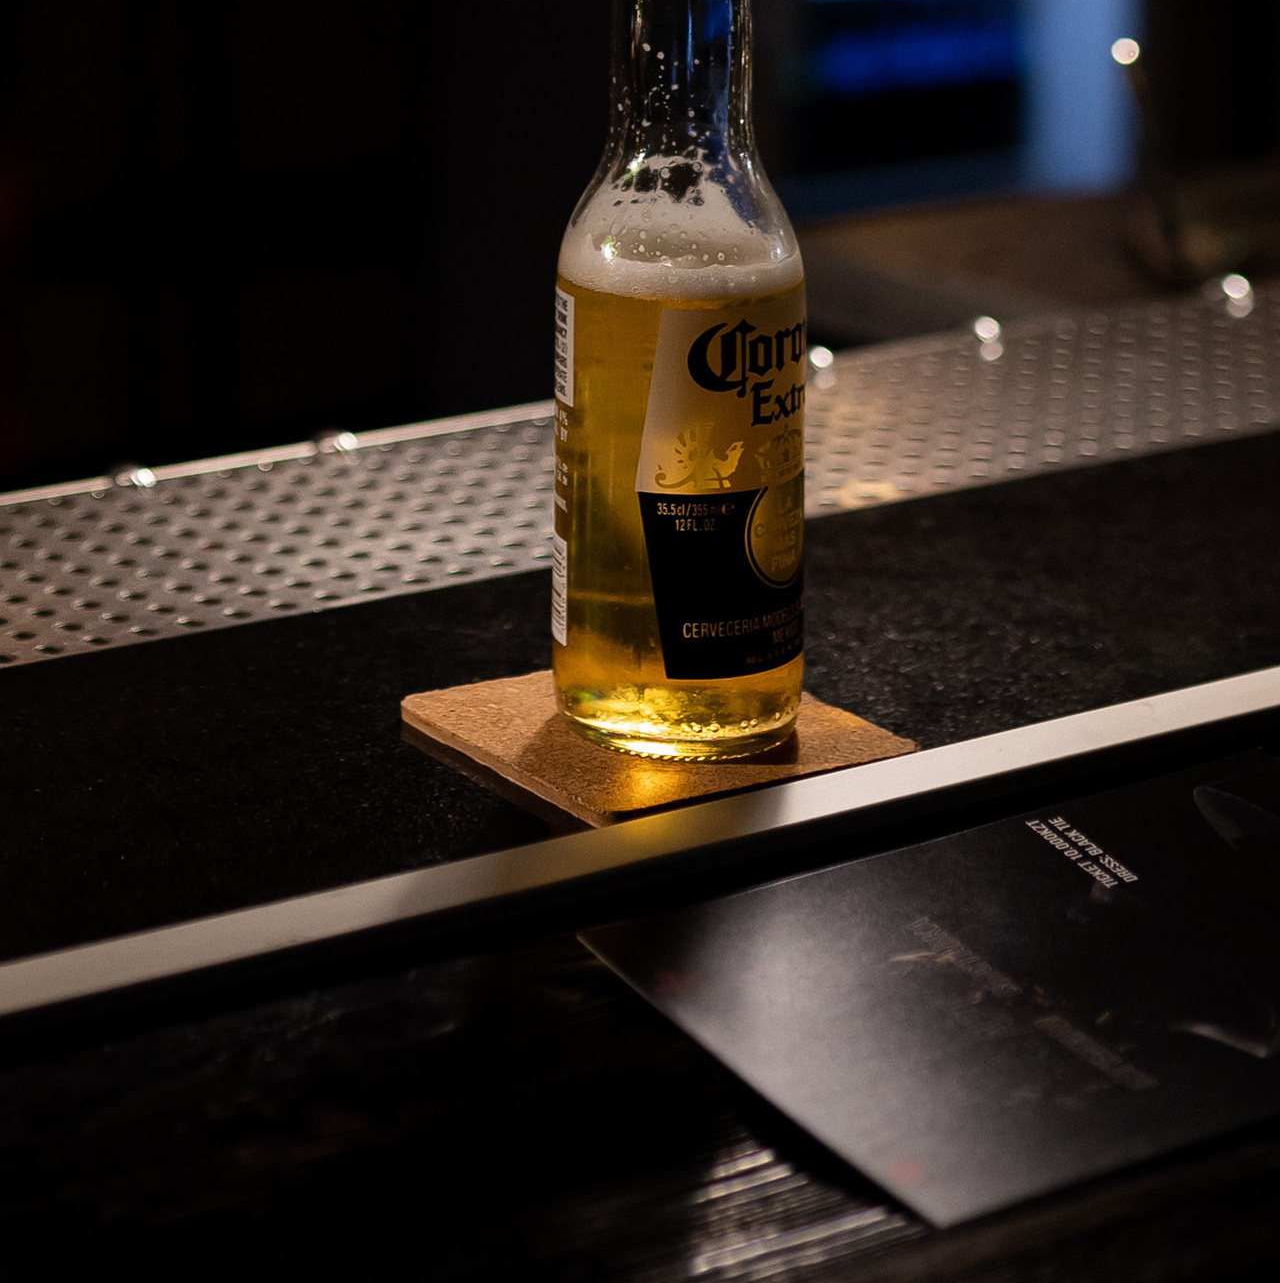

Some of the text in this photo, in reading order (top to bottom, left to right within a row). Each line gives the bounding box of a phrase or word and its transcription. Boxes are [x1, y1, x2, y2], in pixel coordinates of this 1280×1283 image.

[688, 319, 805, 398] Coro
[751, 379, 805, 426] Extr
[682, 616, 760, 639] CERVECERIA
[1048, 816, 1071, 832] TIE
[1025, 819, 1119, 889] TICKET 10.000KZT
[1065, 829, 1103, 857] BLACK
